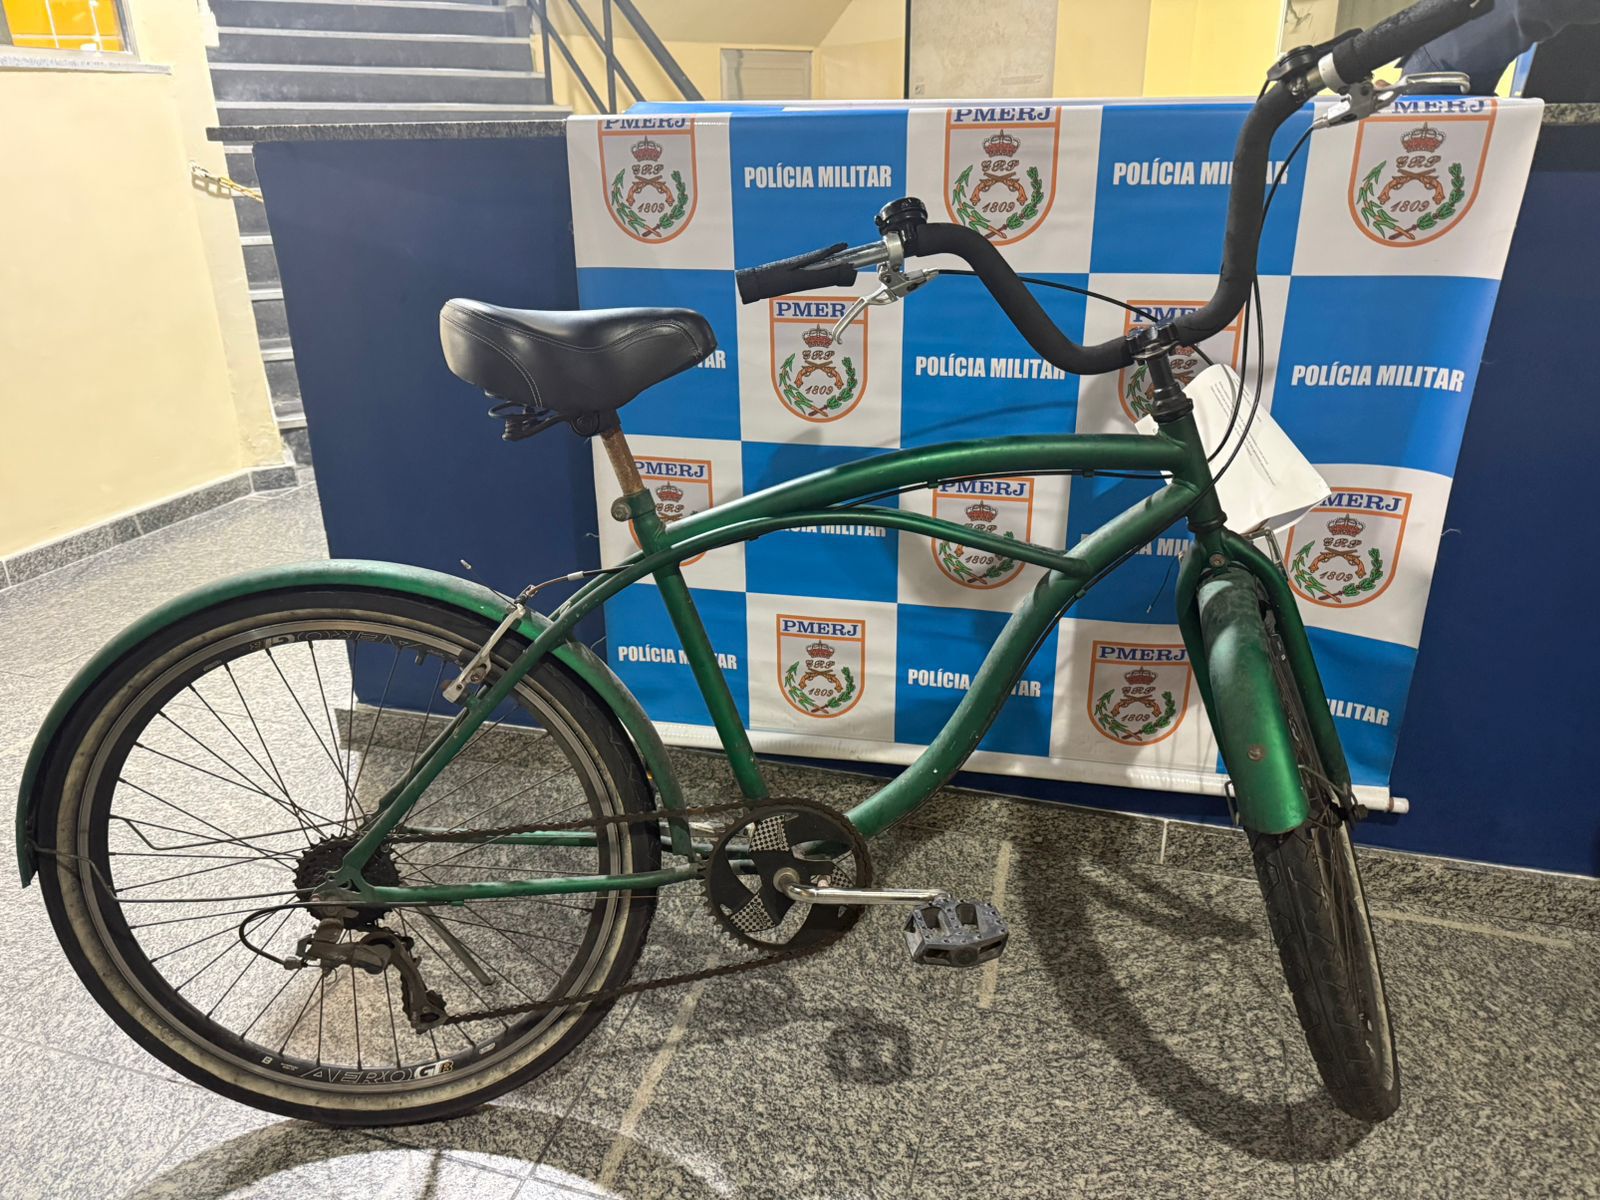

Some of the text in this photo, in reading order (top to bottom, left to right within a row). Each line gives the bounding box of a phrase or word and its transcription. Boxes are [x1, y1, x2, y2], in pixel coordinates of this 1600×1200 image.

[953, 107, 1051, 122] PMERJ
[1391, 101, 1485, 114] MERJ
[604, 117, 687, 129] PMERJ
[743, 162, 892, 188] POLÍCIA MILITAR
[1112, 158, 1195, 185] POLÍCIA
[637, 202, 665, 213] 1809
[981, 200, 1015, 213] 1809
[1390, 200, 1430, 213] 1809
[776, 302, 846, 318] PMER
[915, 353, 986, 378] POLÍCIA
[1290, 361, 1465, 392] POLÍCIA MILITAR
[804, 385, 833, 395] 1809
[940, 480, 1026, 496] PMERJ
[1319, 493, 1402, 512] MERJ
[965, 555, 995, 565] 1809
[1319, 571, 1354, 582] 1809
[782, 619, 859, 637] PMERJ
[618, 644, 676, 664] POLÍCIA
[1098, 645, 1188, 661] PMERJ
[908, 667, 970, 690] POLÍCIA
[808, 687, 834, 697] 1809
[1120, 712, 1151, 722] 1809
[1326, 698, 1390, 726] ILITAR
